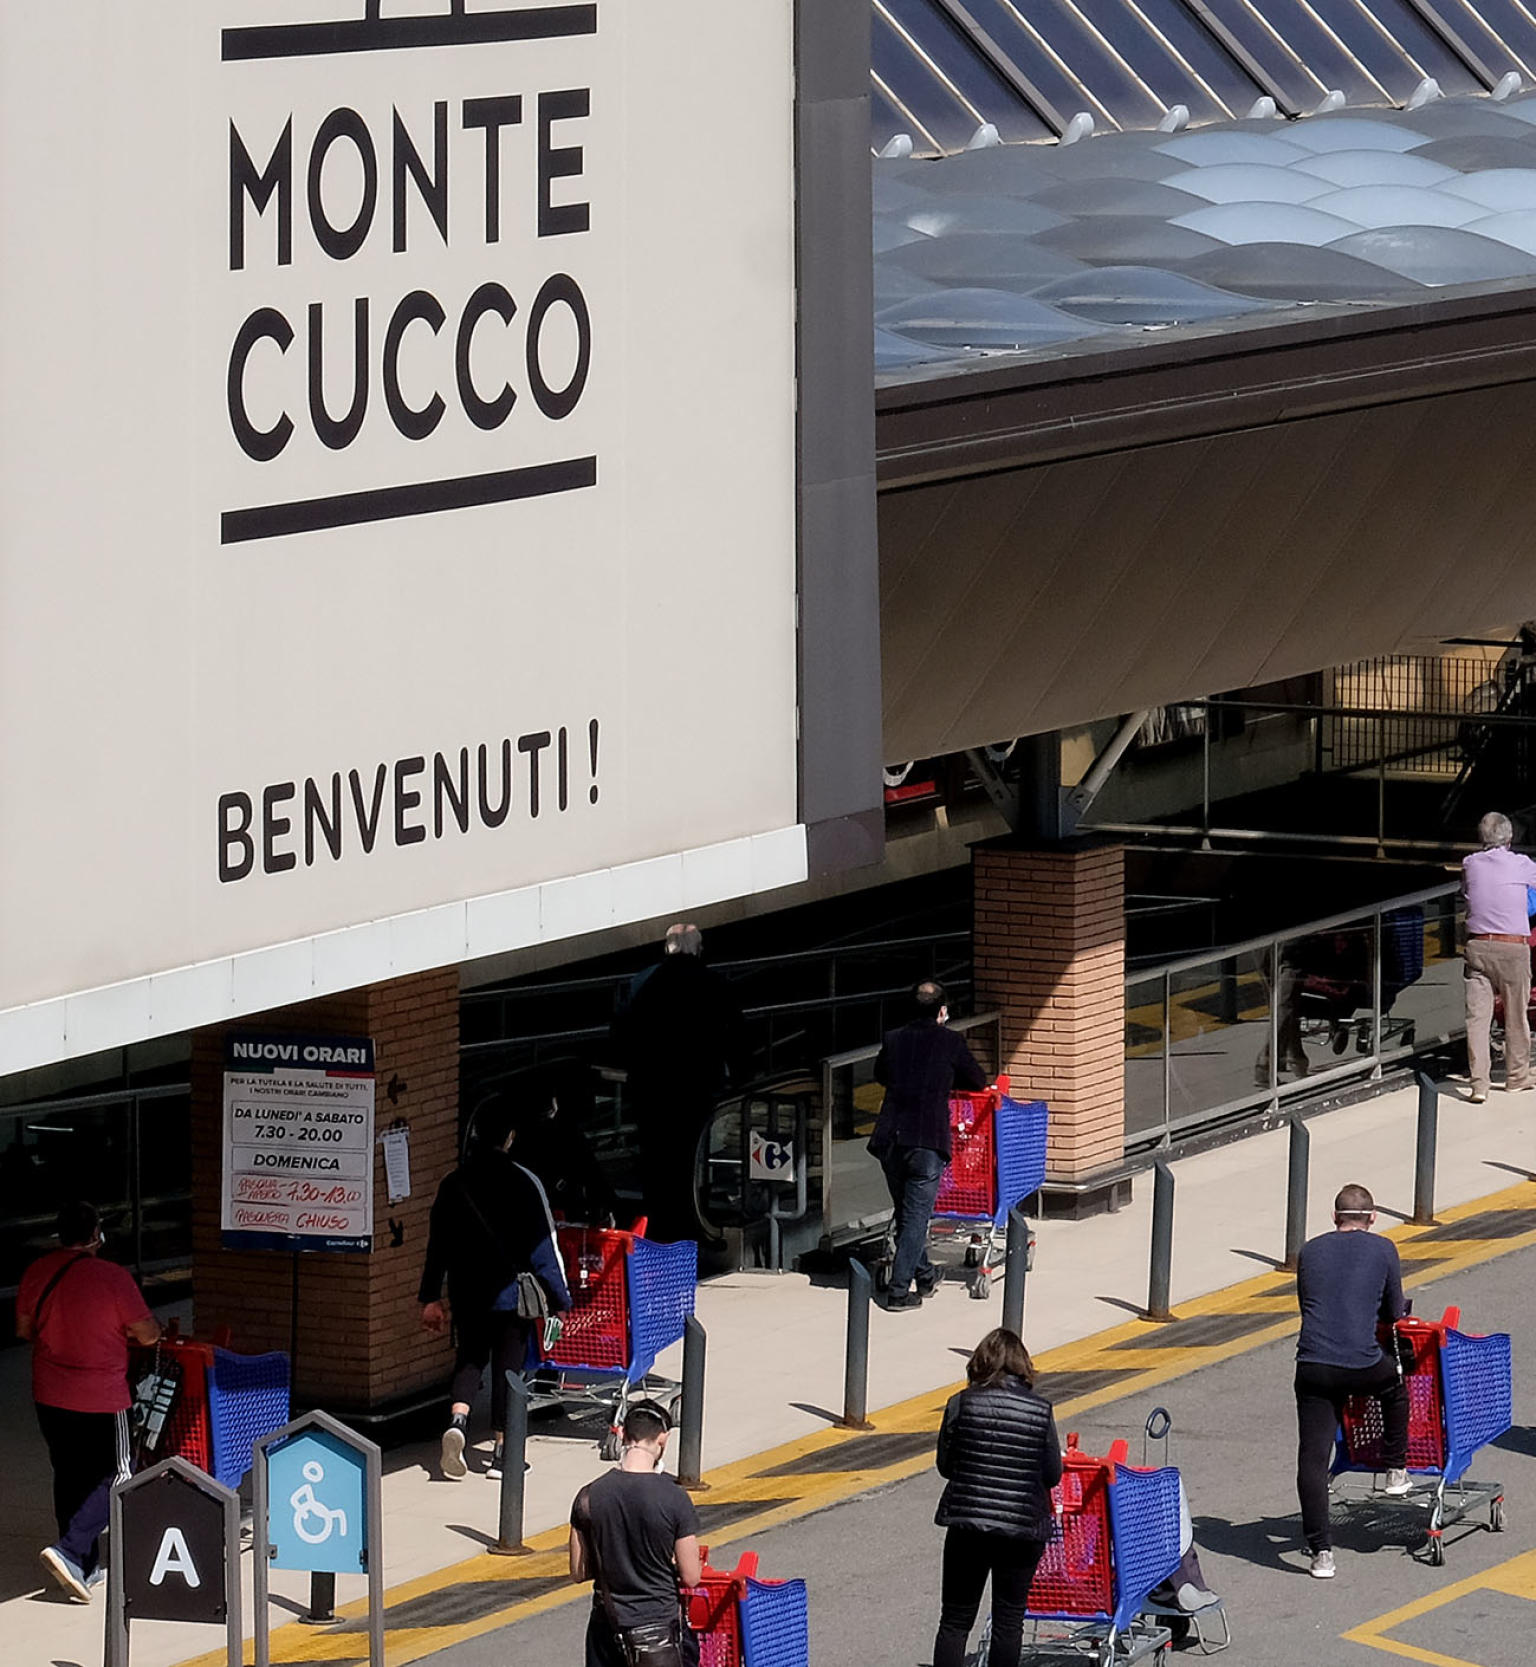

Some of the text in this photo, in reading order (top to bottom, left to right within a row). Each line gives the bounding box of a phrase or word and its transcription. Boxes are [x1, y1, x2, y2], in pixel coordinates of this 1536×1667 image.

[230, 88, 590, 271] MONTE
[228, 273, 592, 462] CUCCO
[233, 1042, 367, 1064] NUOVI ORARI
[234, 1108, 252, 1118] DA
[304, 1112, 312, 1122] A
[315, 1112, 364, 1125] SABATO
[254, 1125, 286, 1139] 7.30
[298, 1127, 343, 1142] 20.00
[253, 1154, 340, 1171] DOMENICA
[295, 1212, 350, 1230] CHIUSO
[149, 1527, 201, 1588] A
